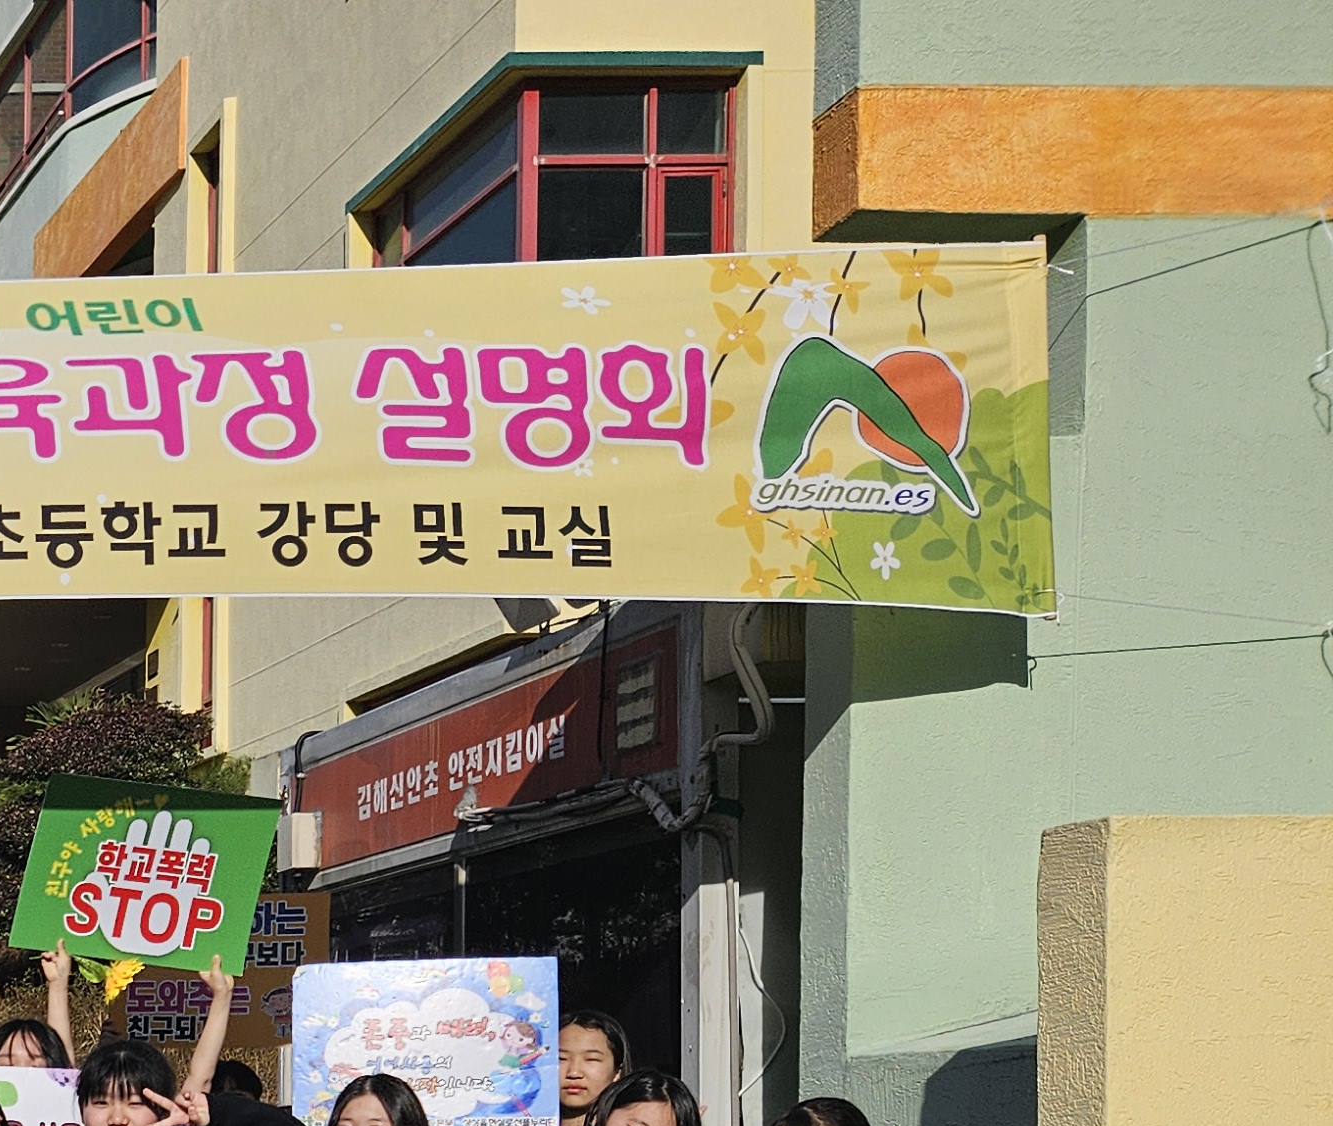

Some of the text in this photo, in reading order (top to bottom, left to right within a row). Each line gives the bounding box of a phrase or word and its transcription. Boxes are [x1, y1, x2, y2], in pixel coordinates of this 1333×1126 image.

[27, 297, 204, 336] 어린이
[353, 343, 711, 470] 설명회
[755, 476, 933, 514] ghsinan.es
[256, 501, 381, 569] 강당
[413, 500, 470, 565] 및
[496, 503, 614, 567] 교실
[357, 715, 566, 822] 김해신안초 안전지킴이실
[95, 840, 219, 895] 학교폭력
[63, 880, 226, 952] STOP
[362, 1016, 496, 1051] 존중과 배려,
